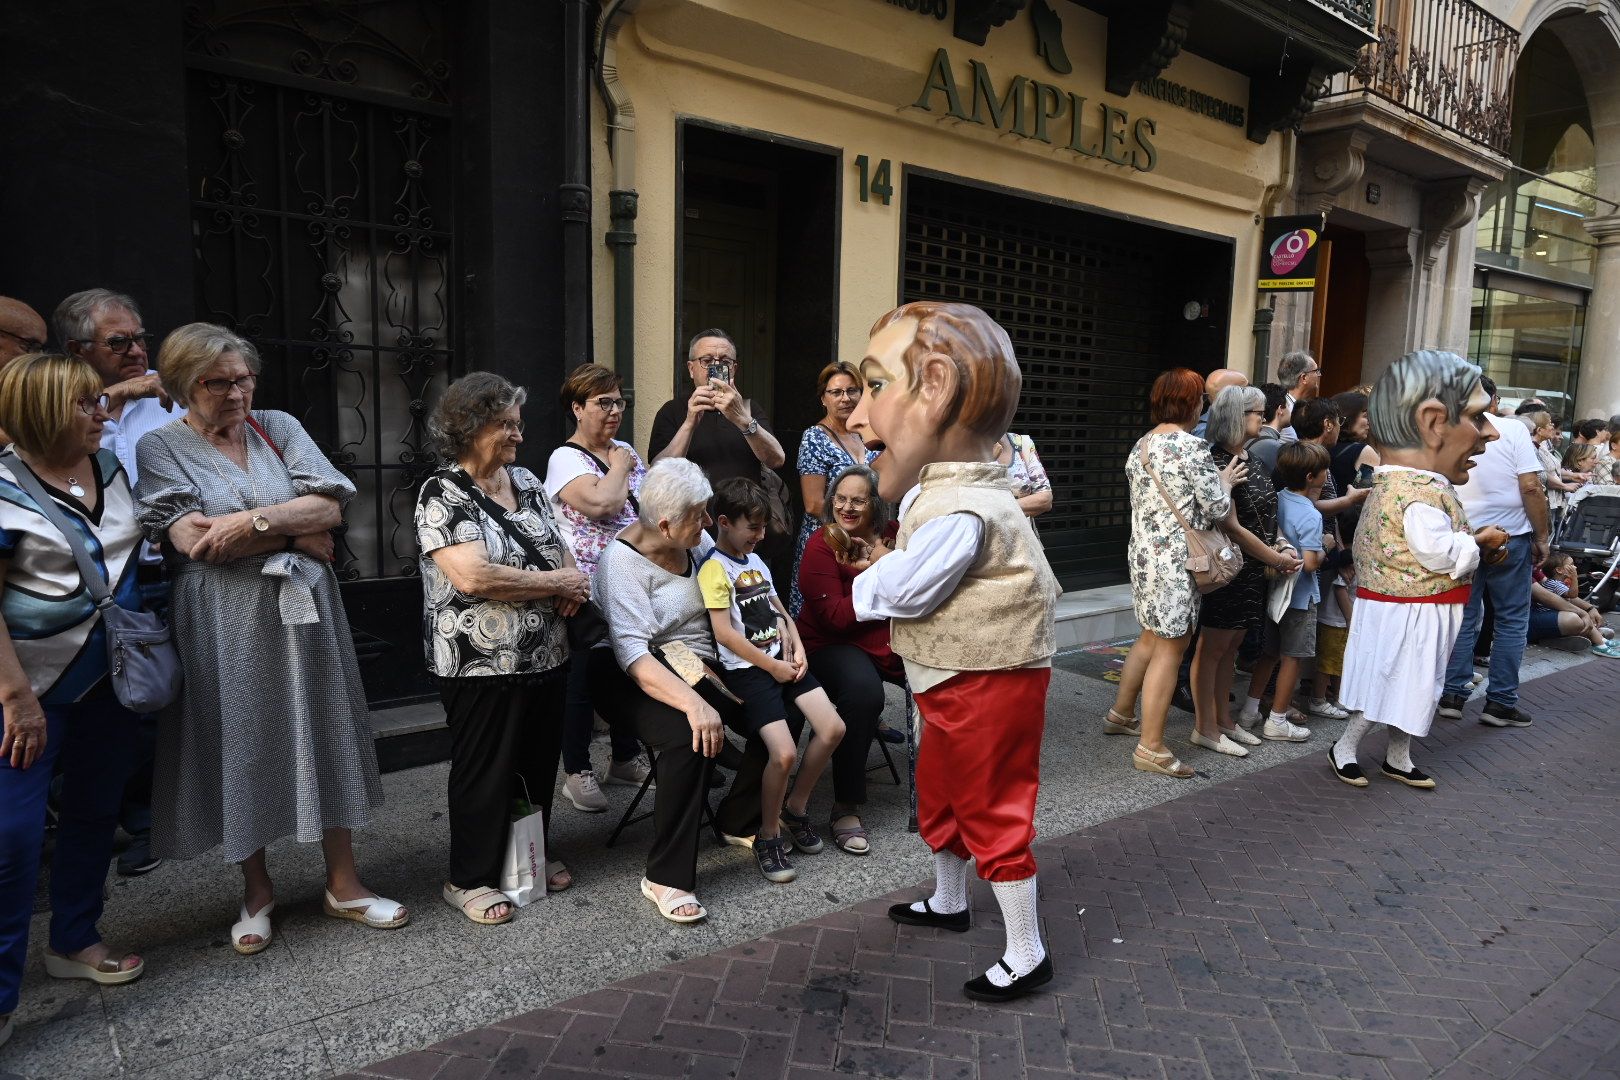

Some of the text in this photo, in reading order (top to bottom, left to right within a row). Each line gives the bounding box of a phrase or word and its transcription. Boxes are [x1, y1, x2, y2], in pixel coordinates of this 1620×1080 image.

[912, 48, 1158, 172] AMPLES
[1139, 78, 1245, 127] ANCHOS ESPECIALES
[854, 154, 893, 206] 14
